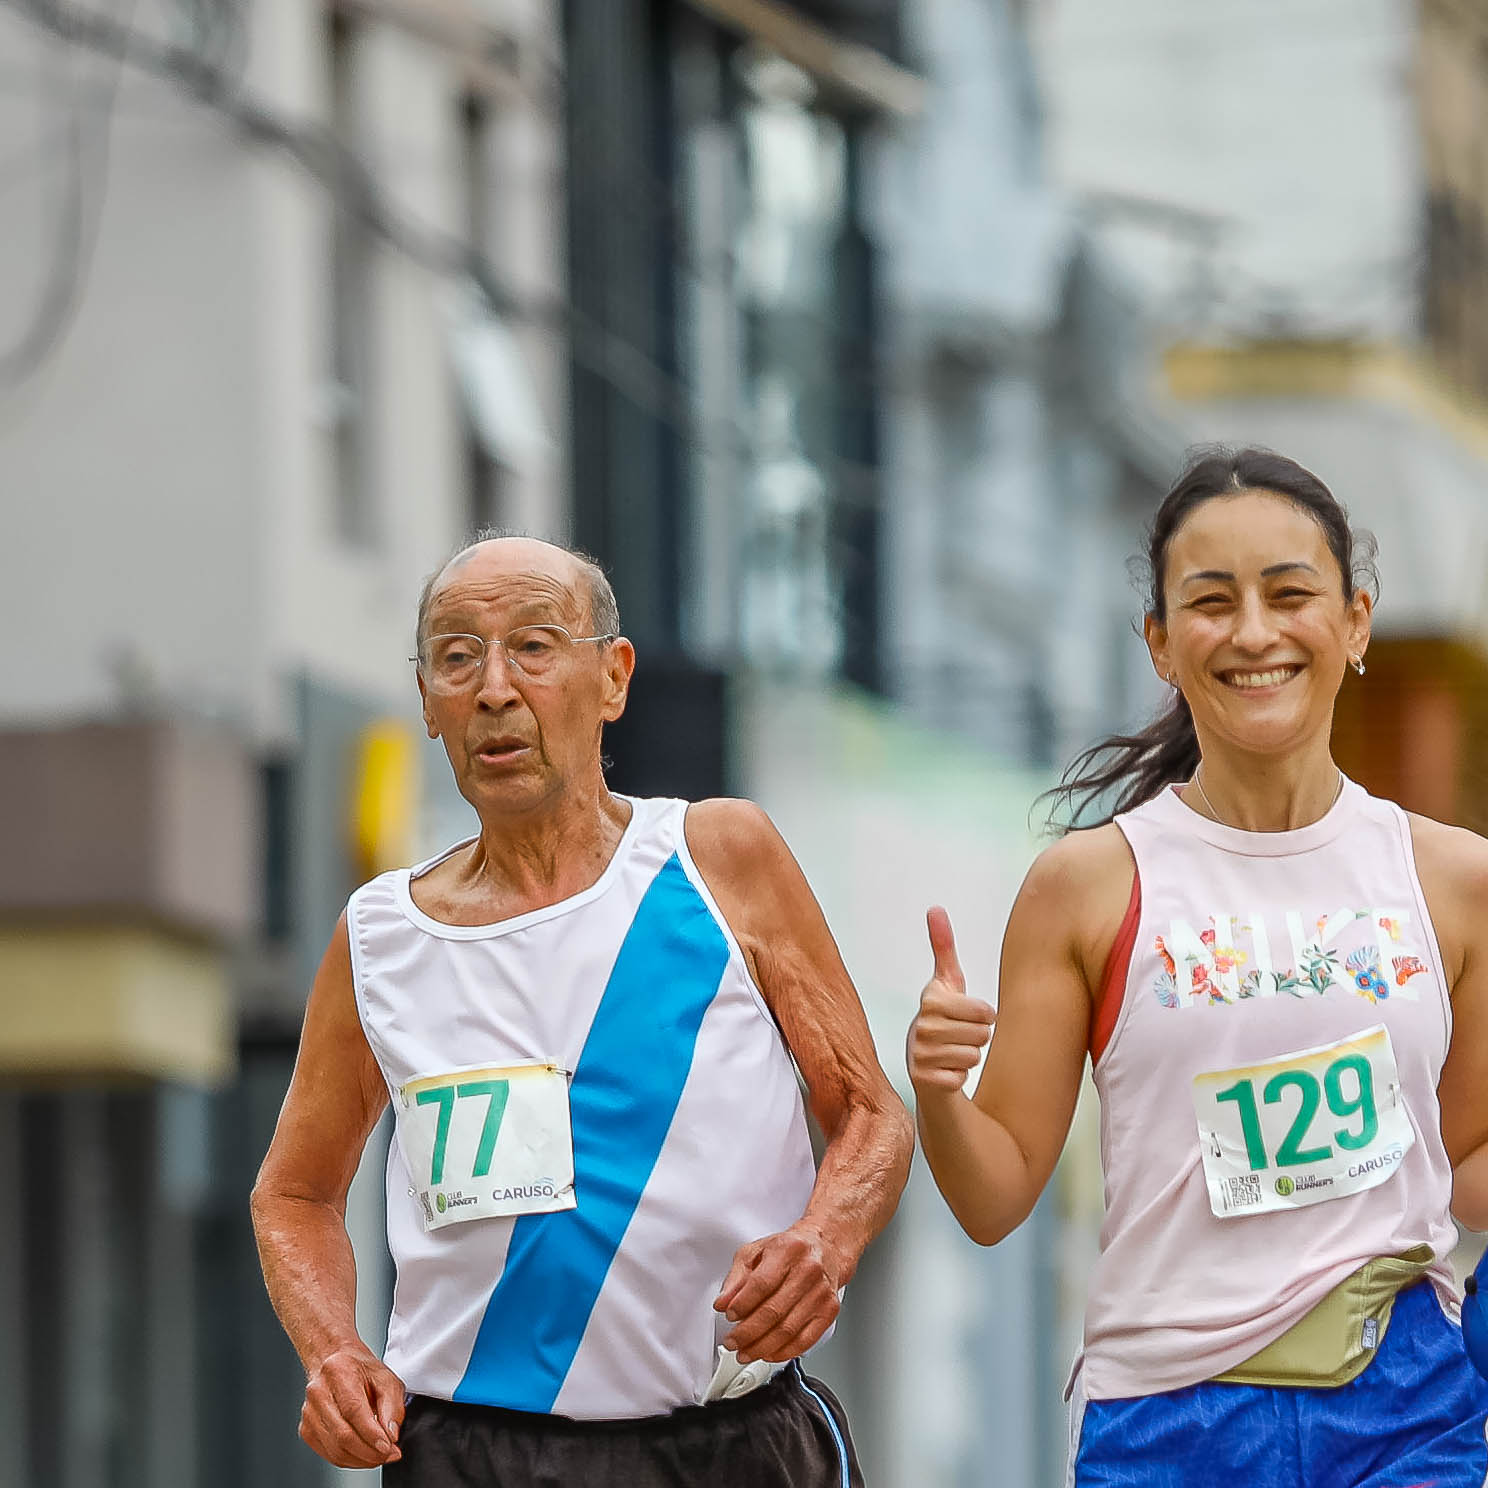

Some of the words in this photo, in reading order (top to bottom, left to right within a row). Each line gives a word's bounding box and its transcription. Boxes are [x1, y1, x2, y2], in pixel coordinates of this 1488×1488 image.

[1153, 908, 1429, 1009] NIKE
[416, 1079, 510, 1185] 77
[1216, 1053, 1379, 1171] 129
[492, 1184, 554, 1201] CARUSO
[1348, 1149, 1404, 1178] CARUSO
